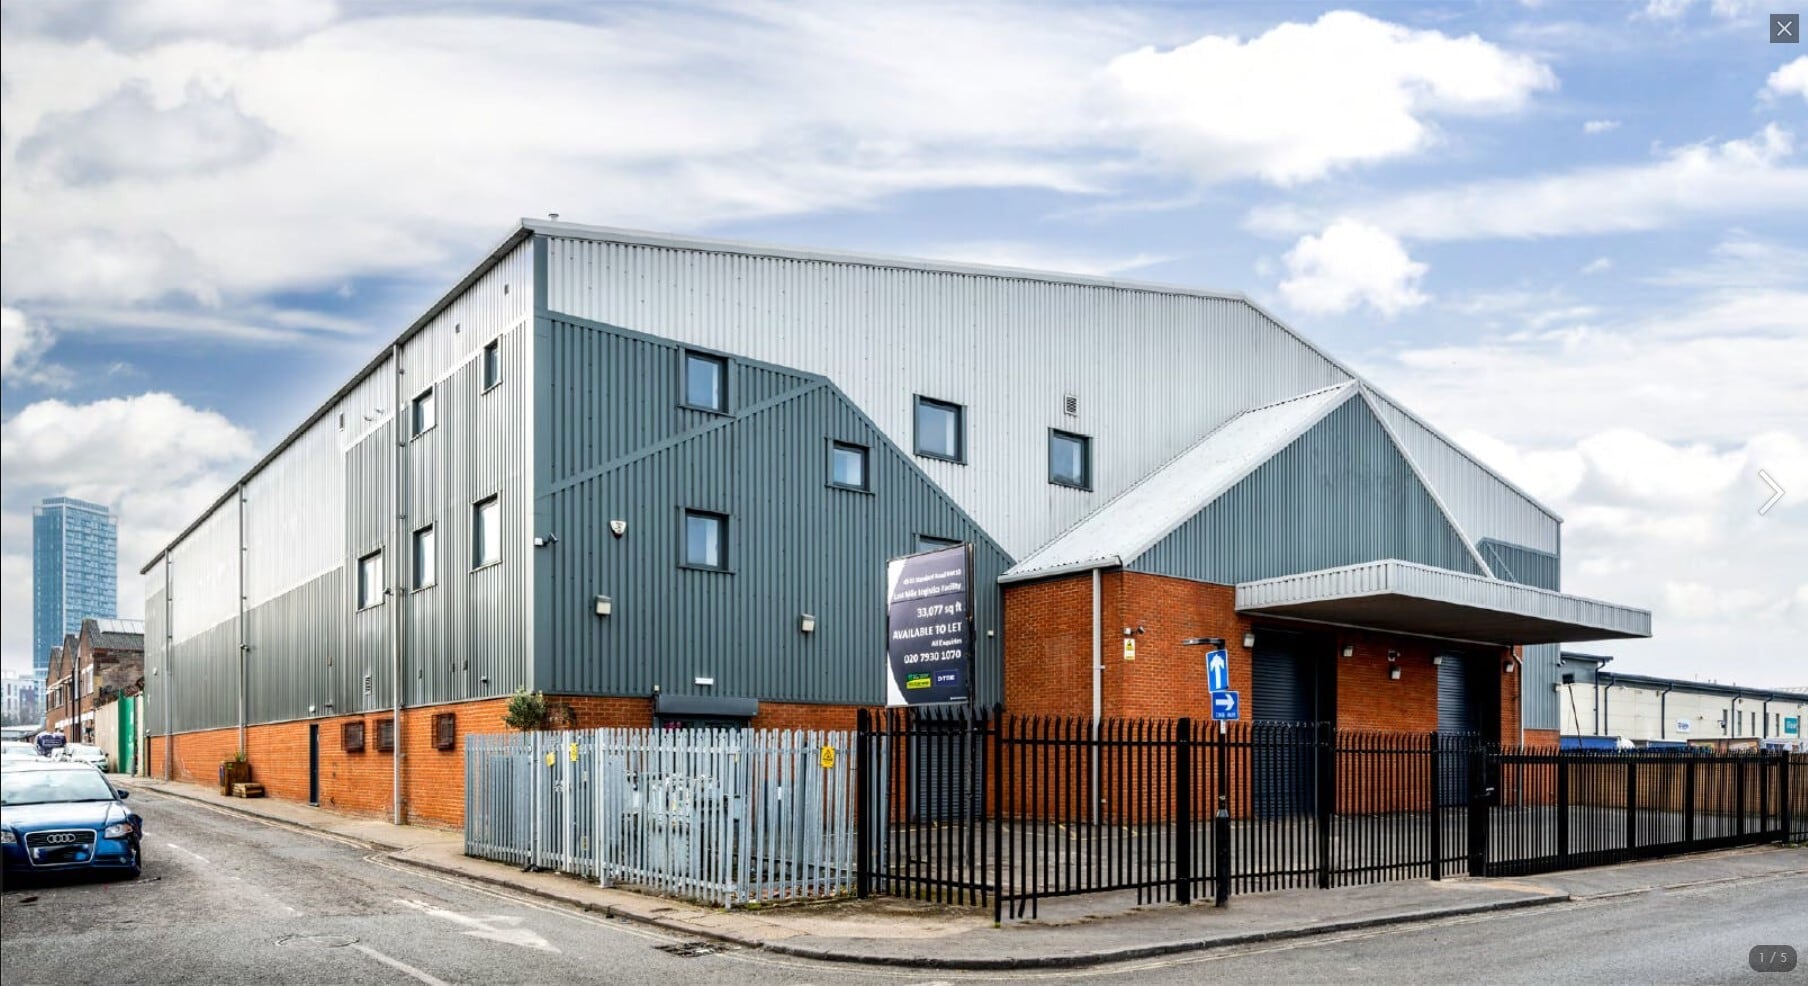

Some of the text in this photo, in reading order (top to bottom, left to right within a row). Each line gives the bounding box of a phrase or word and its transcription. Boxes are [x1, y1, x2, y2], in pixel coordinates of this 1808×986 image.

[941, 583, 962, 592] Facility
[917, 601, 962, 618] 33,077 sq ft
[892, 622, 962, 640] AVAILABLE TO LET
[904, 649, 961, 664] 020 7930 1070
